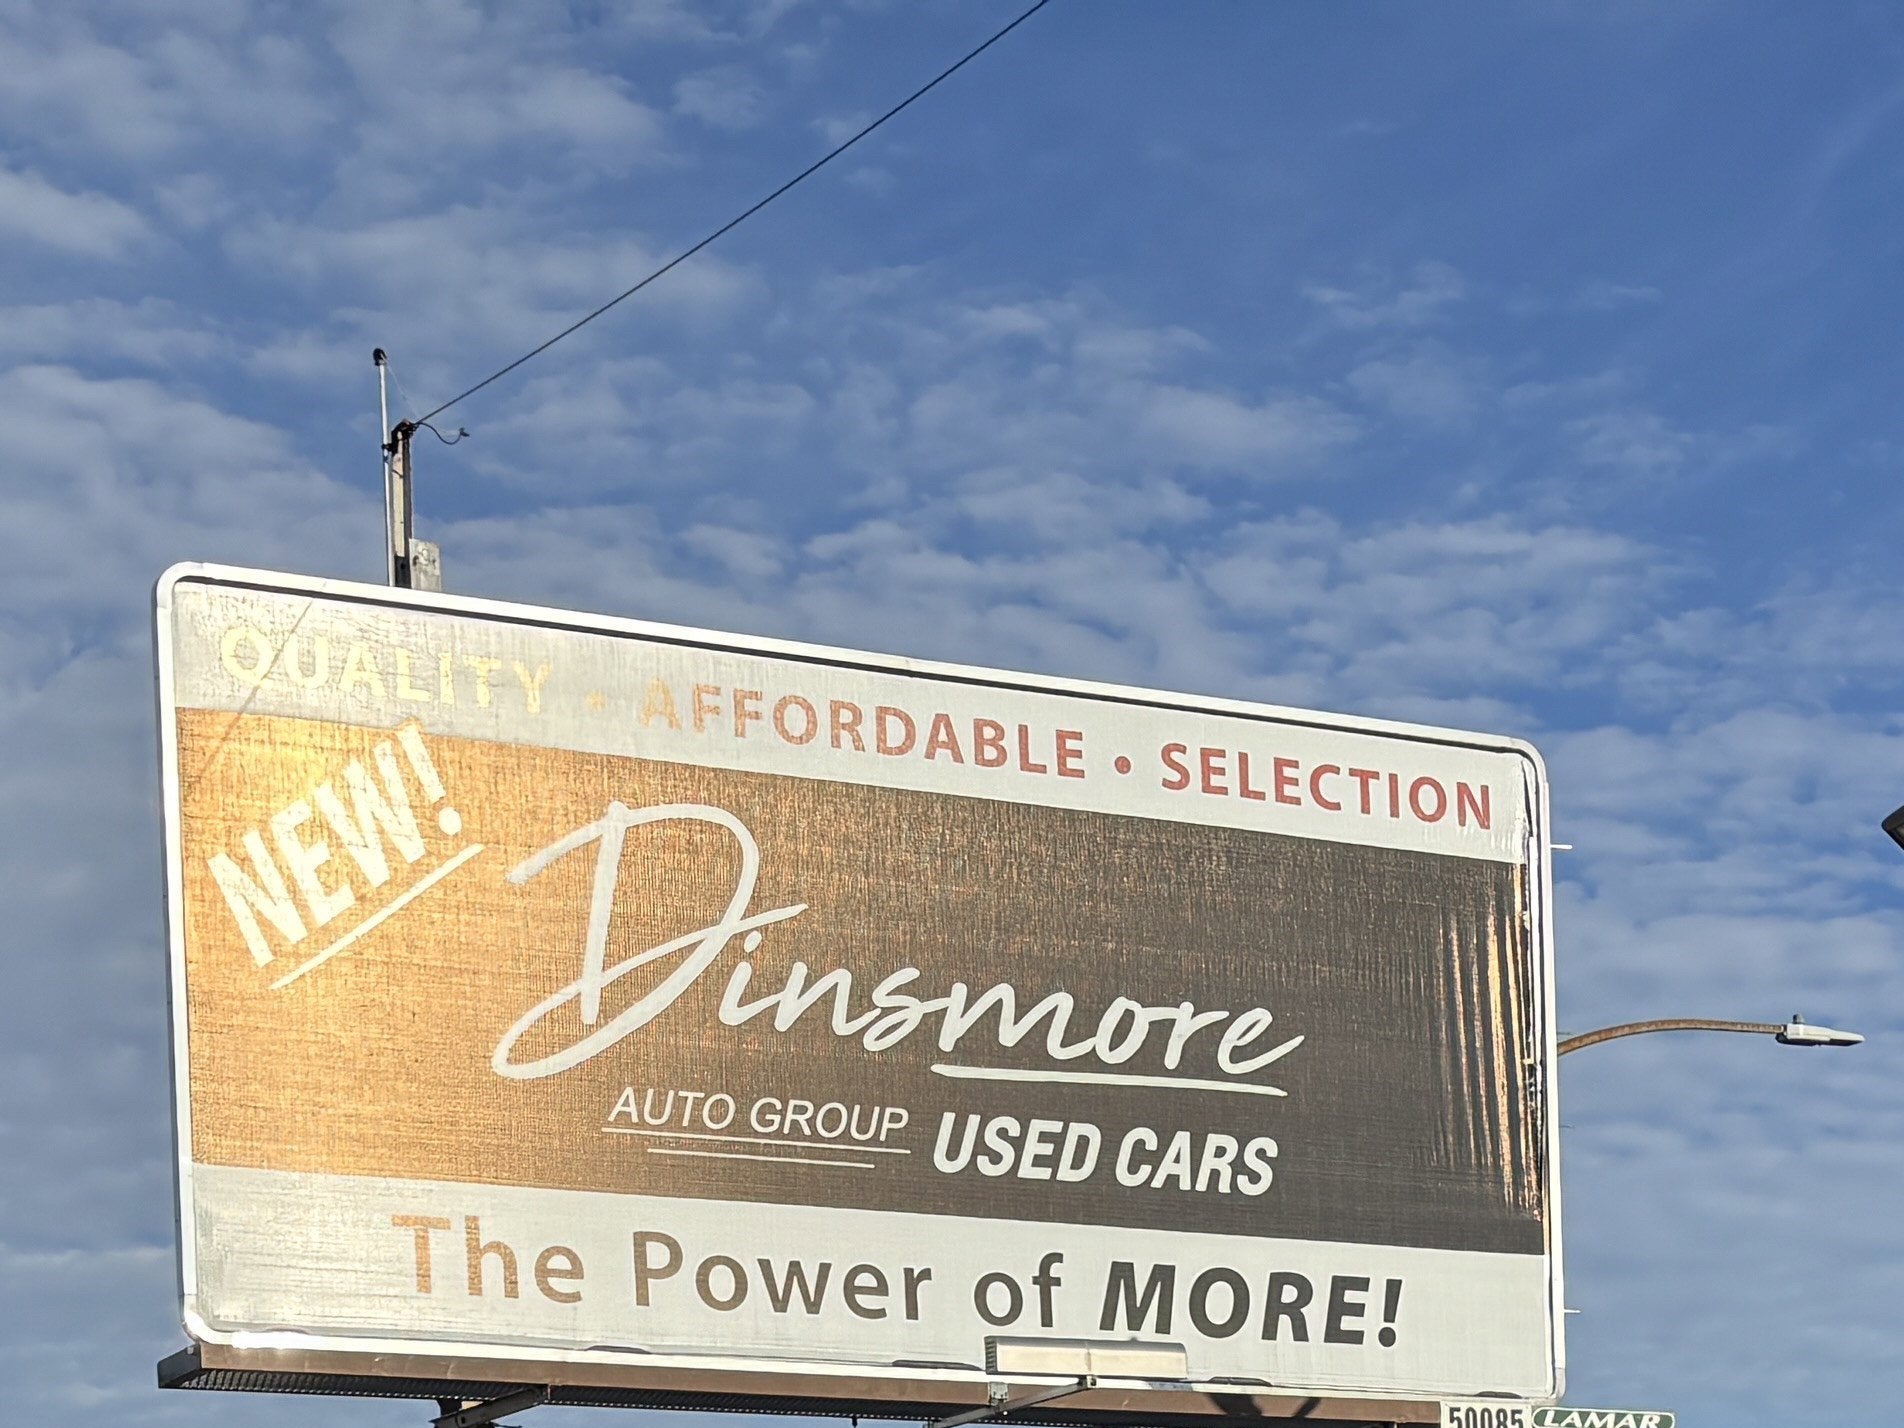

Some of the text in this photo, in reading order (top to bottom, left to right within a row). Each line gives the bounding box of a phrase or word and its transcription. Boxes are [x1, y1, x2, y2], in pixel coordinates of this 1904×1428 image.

[220, 626, 1491, 829] QUALITY AFFORDABLE SELECTION
[206, 716, 463, 968] NEW!
[492, 800, 1306, 1079] Dinsmore
[608, 1087, 910, 1143] AUTO GROUP
[933, 1112, 1278, 1196] USED CARS
[392, 1215, 1403, 1348] The Power of MORE!
